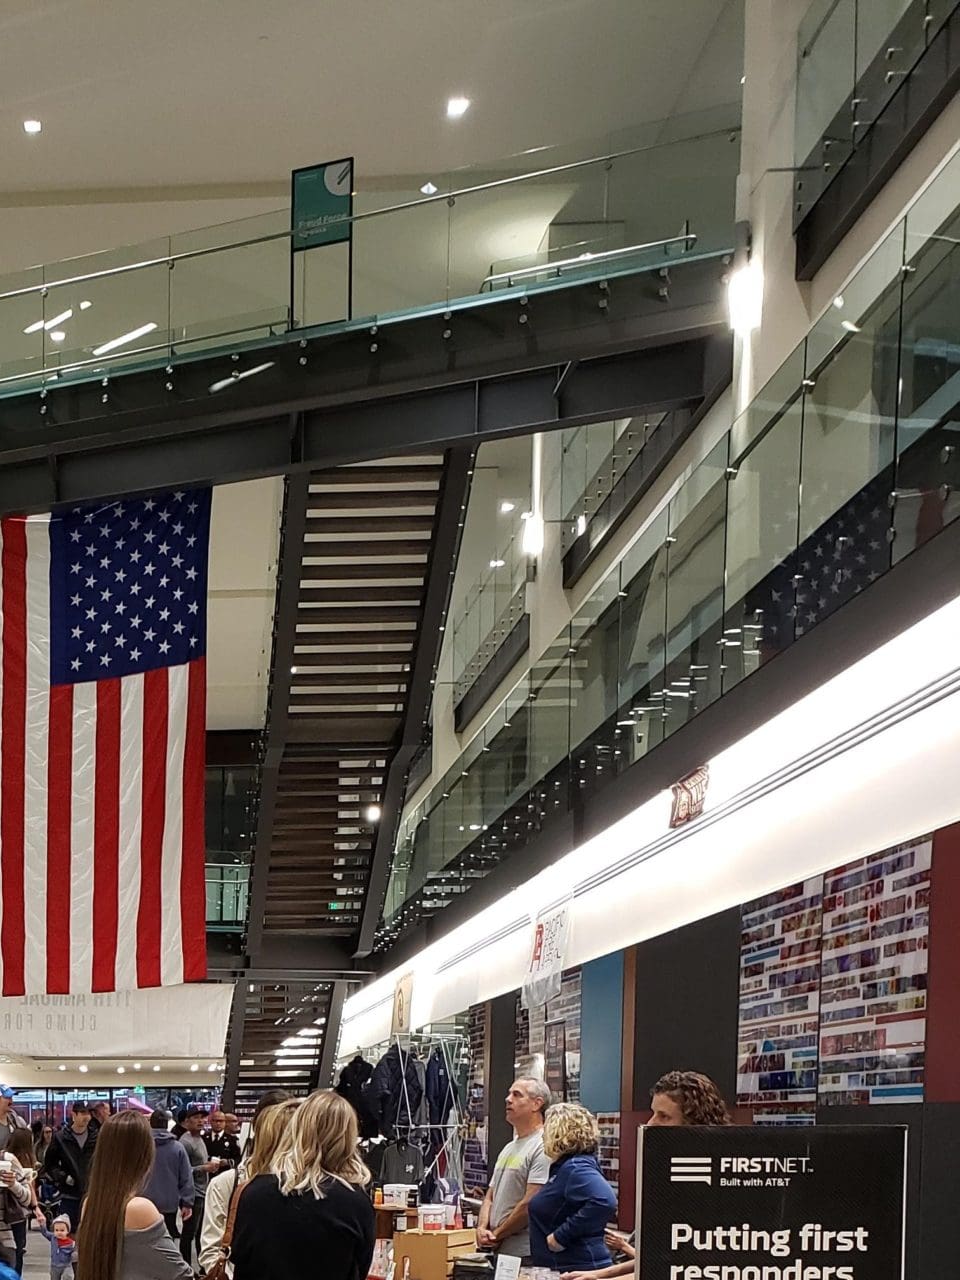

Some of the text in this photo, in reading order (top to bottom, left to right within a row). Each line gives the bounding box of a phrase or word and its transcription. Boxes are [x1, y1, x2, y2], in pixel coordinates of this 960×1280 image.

[719, 1177, 791, 1187] Built with AT&T
[671, 1223, 869, 1257] Putting first
